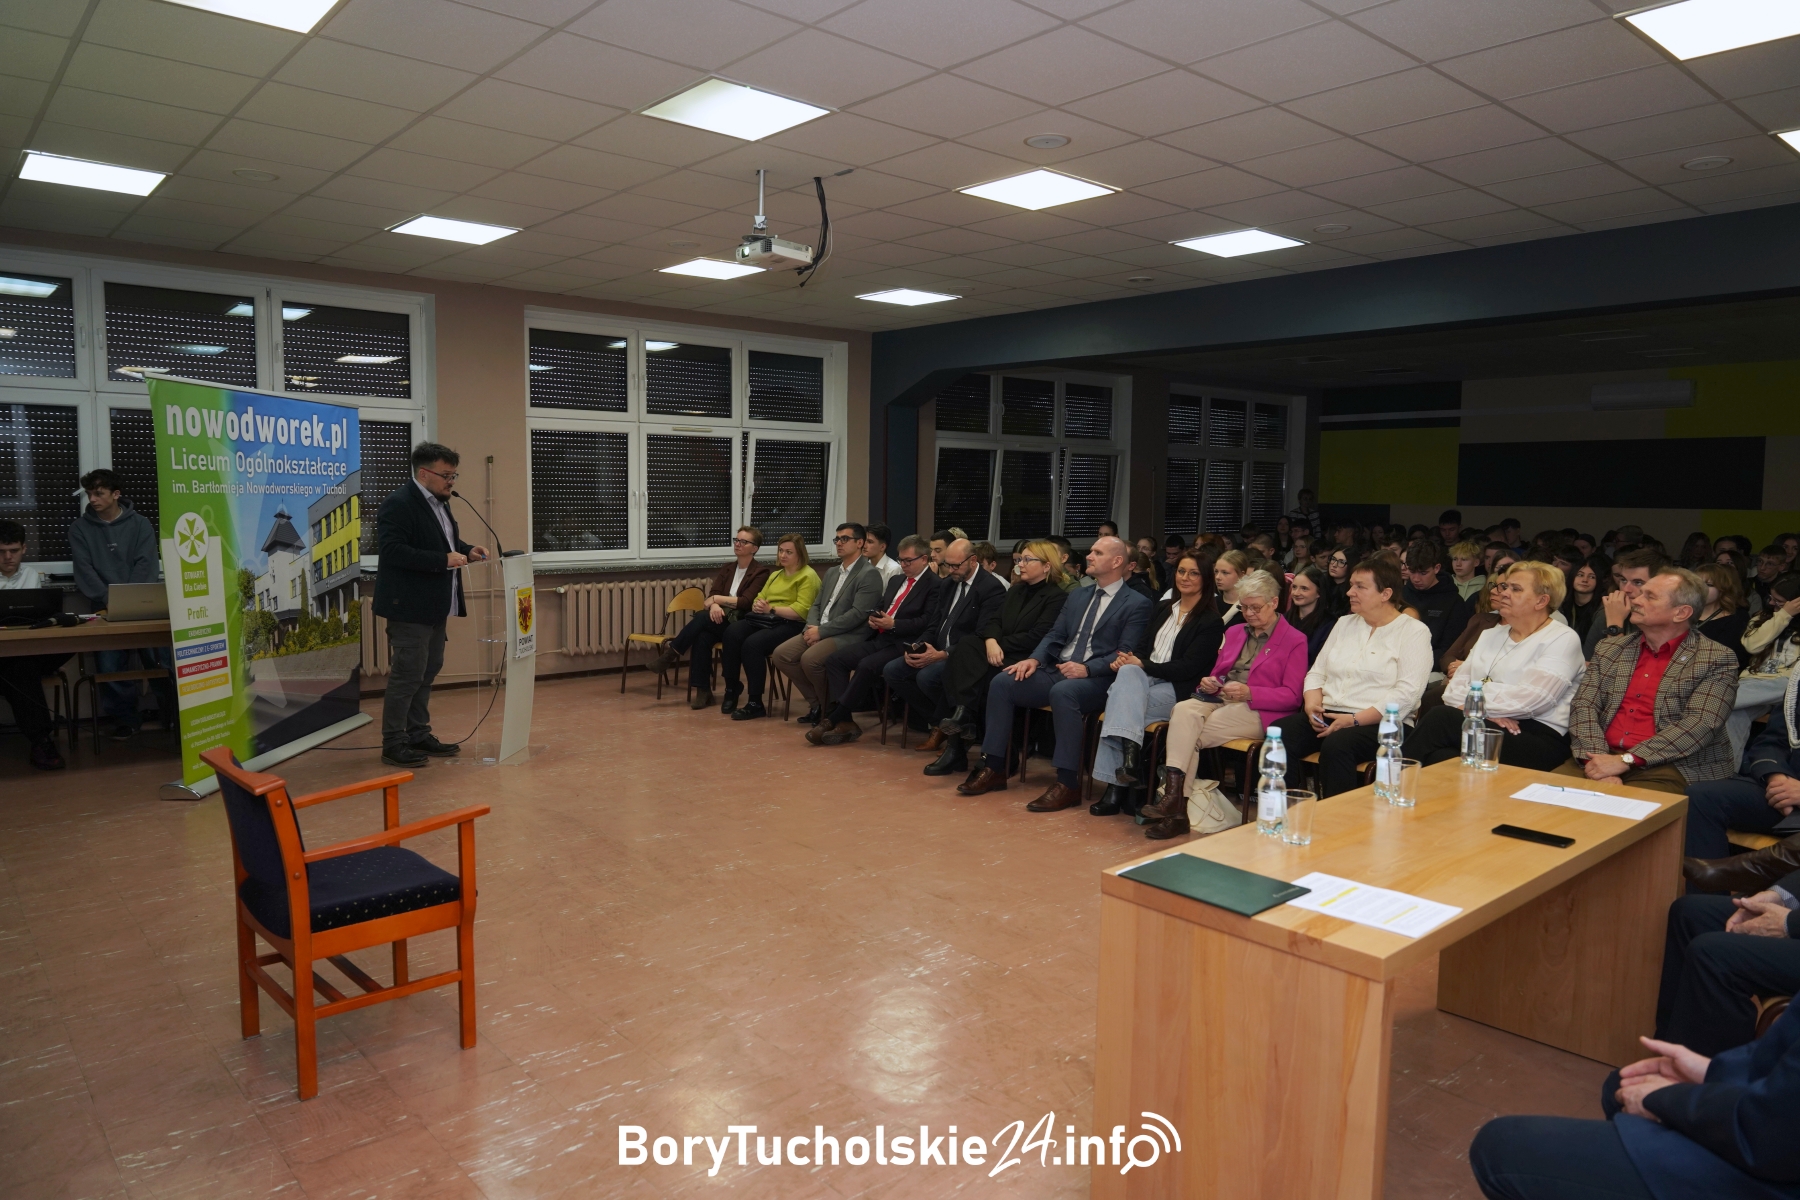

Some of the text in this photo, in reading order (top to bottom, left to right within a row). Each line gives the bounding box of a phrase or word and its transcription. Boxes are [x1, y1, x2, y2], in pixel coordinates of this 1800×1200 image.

[165, 403, 348, 456] nowodworek.pl
[170, 447, 347, 480] Liceum Ogólnokształcące
[172, 480, 347, 497] im. Bartłomieja Nowodworskiego w Tucholi
[187, 606, 209, 620] Profil:
